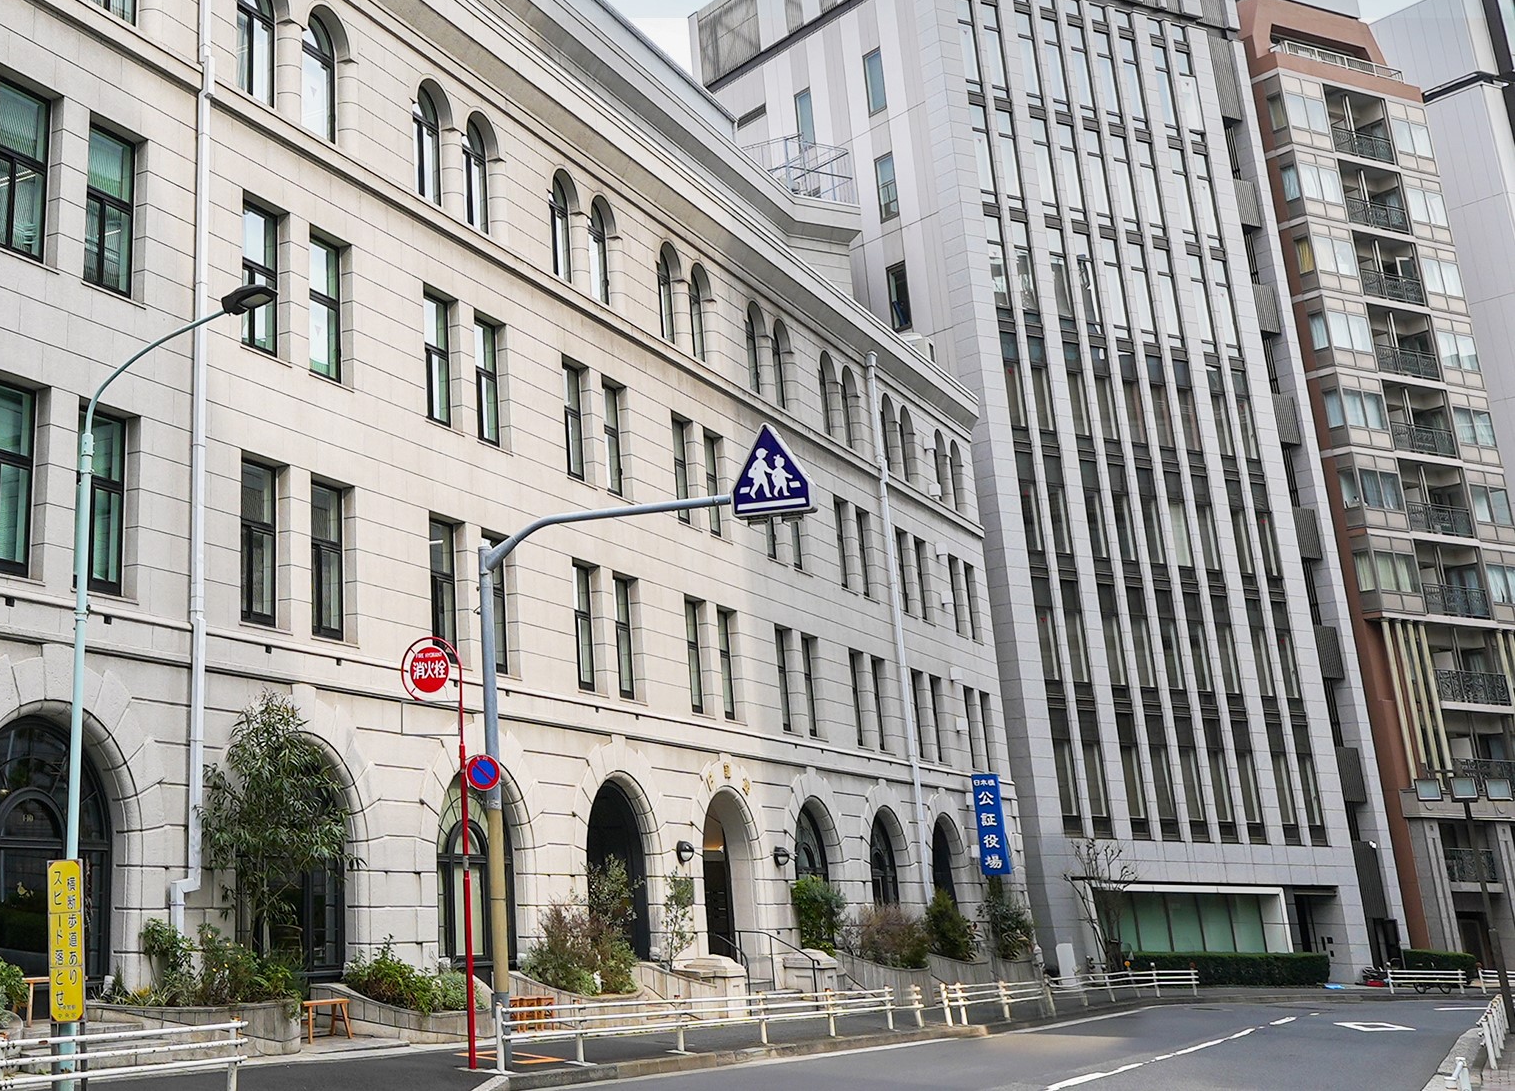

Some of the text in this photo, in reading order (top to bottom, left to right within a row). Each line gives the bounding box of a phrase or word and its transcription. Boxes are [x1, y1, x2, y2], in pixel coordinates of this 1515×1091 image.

[413, 660, 446, 679] 消火栓
[978, 791, 1002, 869] 公証役場
[53, 871, 64, 1007] スピード落とせ
[66, 877, 78, 985] 横断歩道あり
